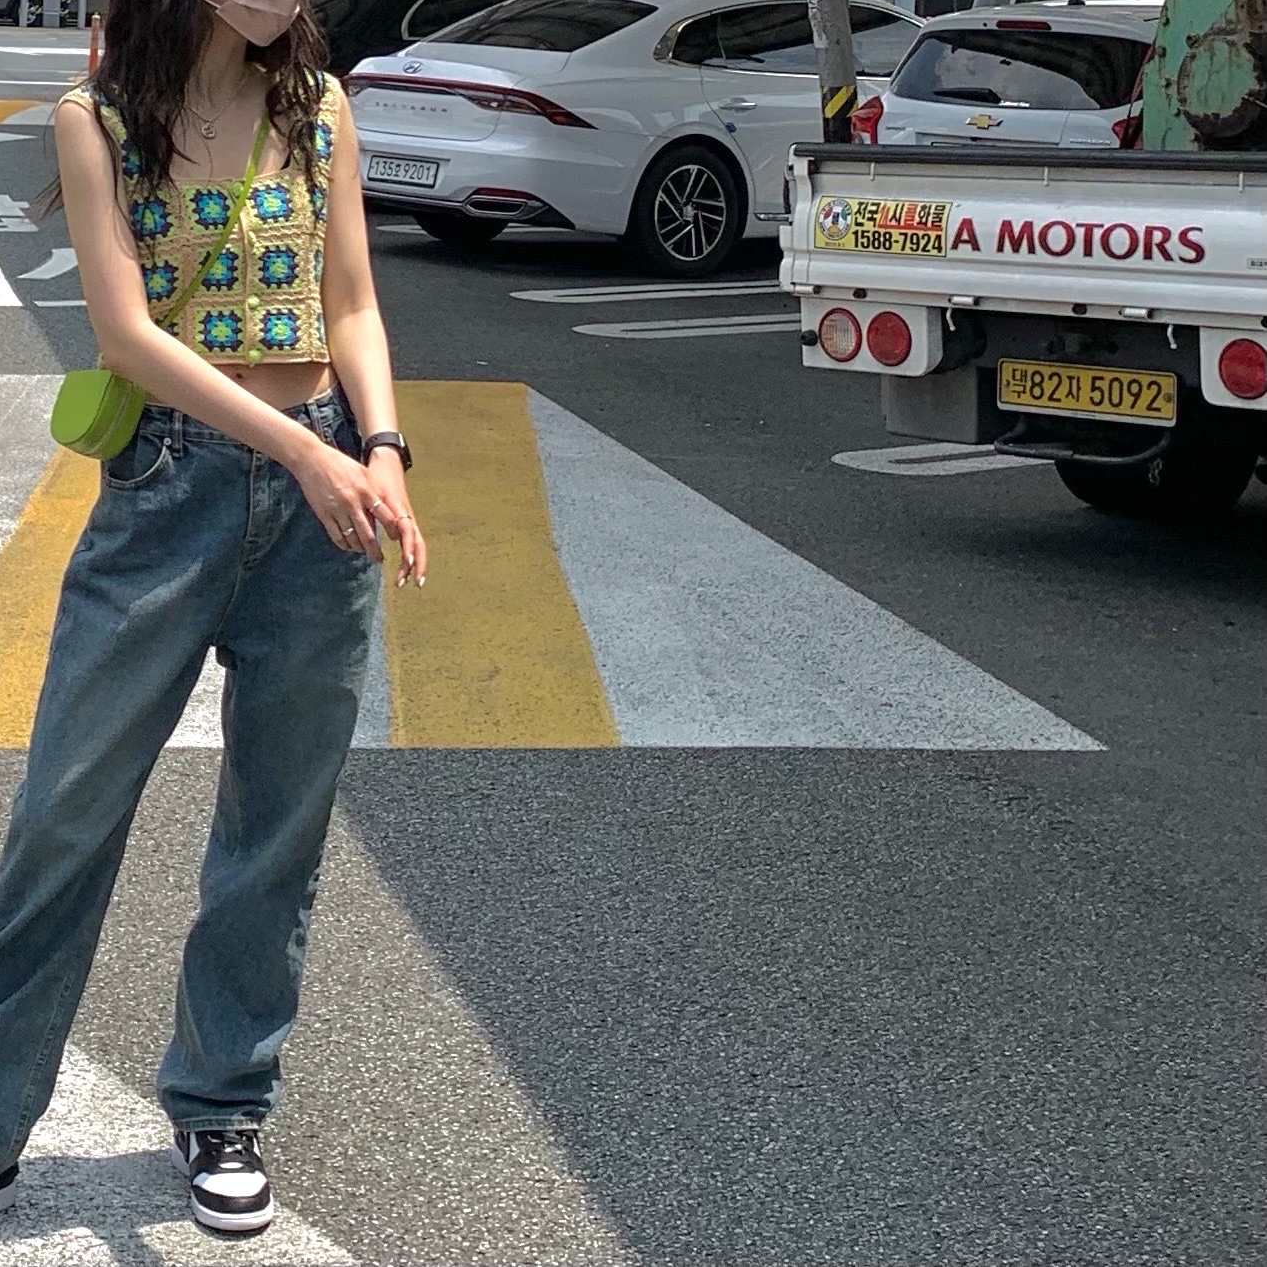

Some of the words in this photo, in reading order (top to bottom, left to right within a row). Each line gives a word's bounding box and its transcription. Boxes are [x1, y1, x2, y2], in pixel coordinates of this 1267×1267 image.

[852, 229, 943, 254] 1588-7924
[996, 219, 1206, 264] MOTORS
[1088, 375, 1163, 413] 5092
